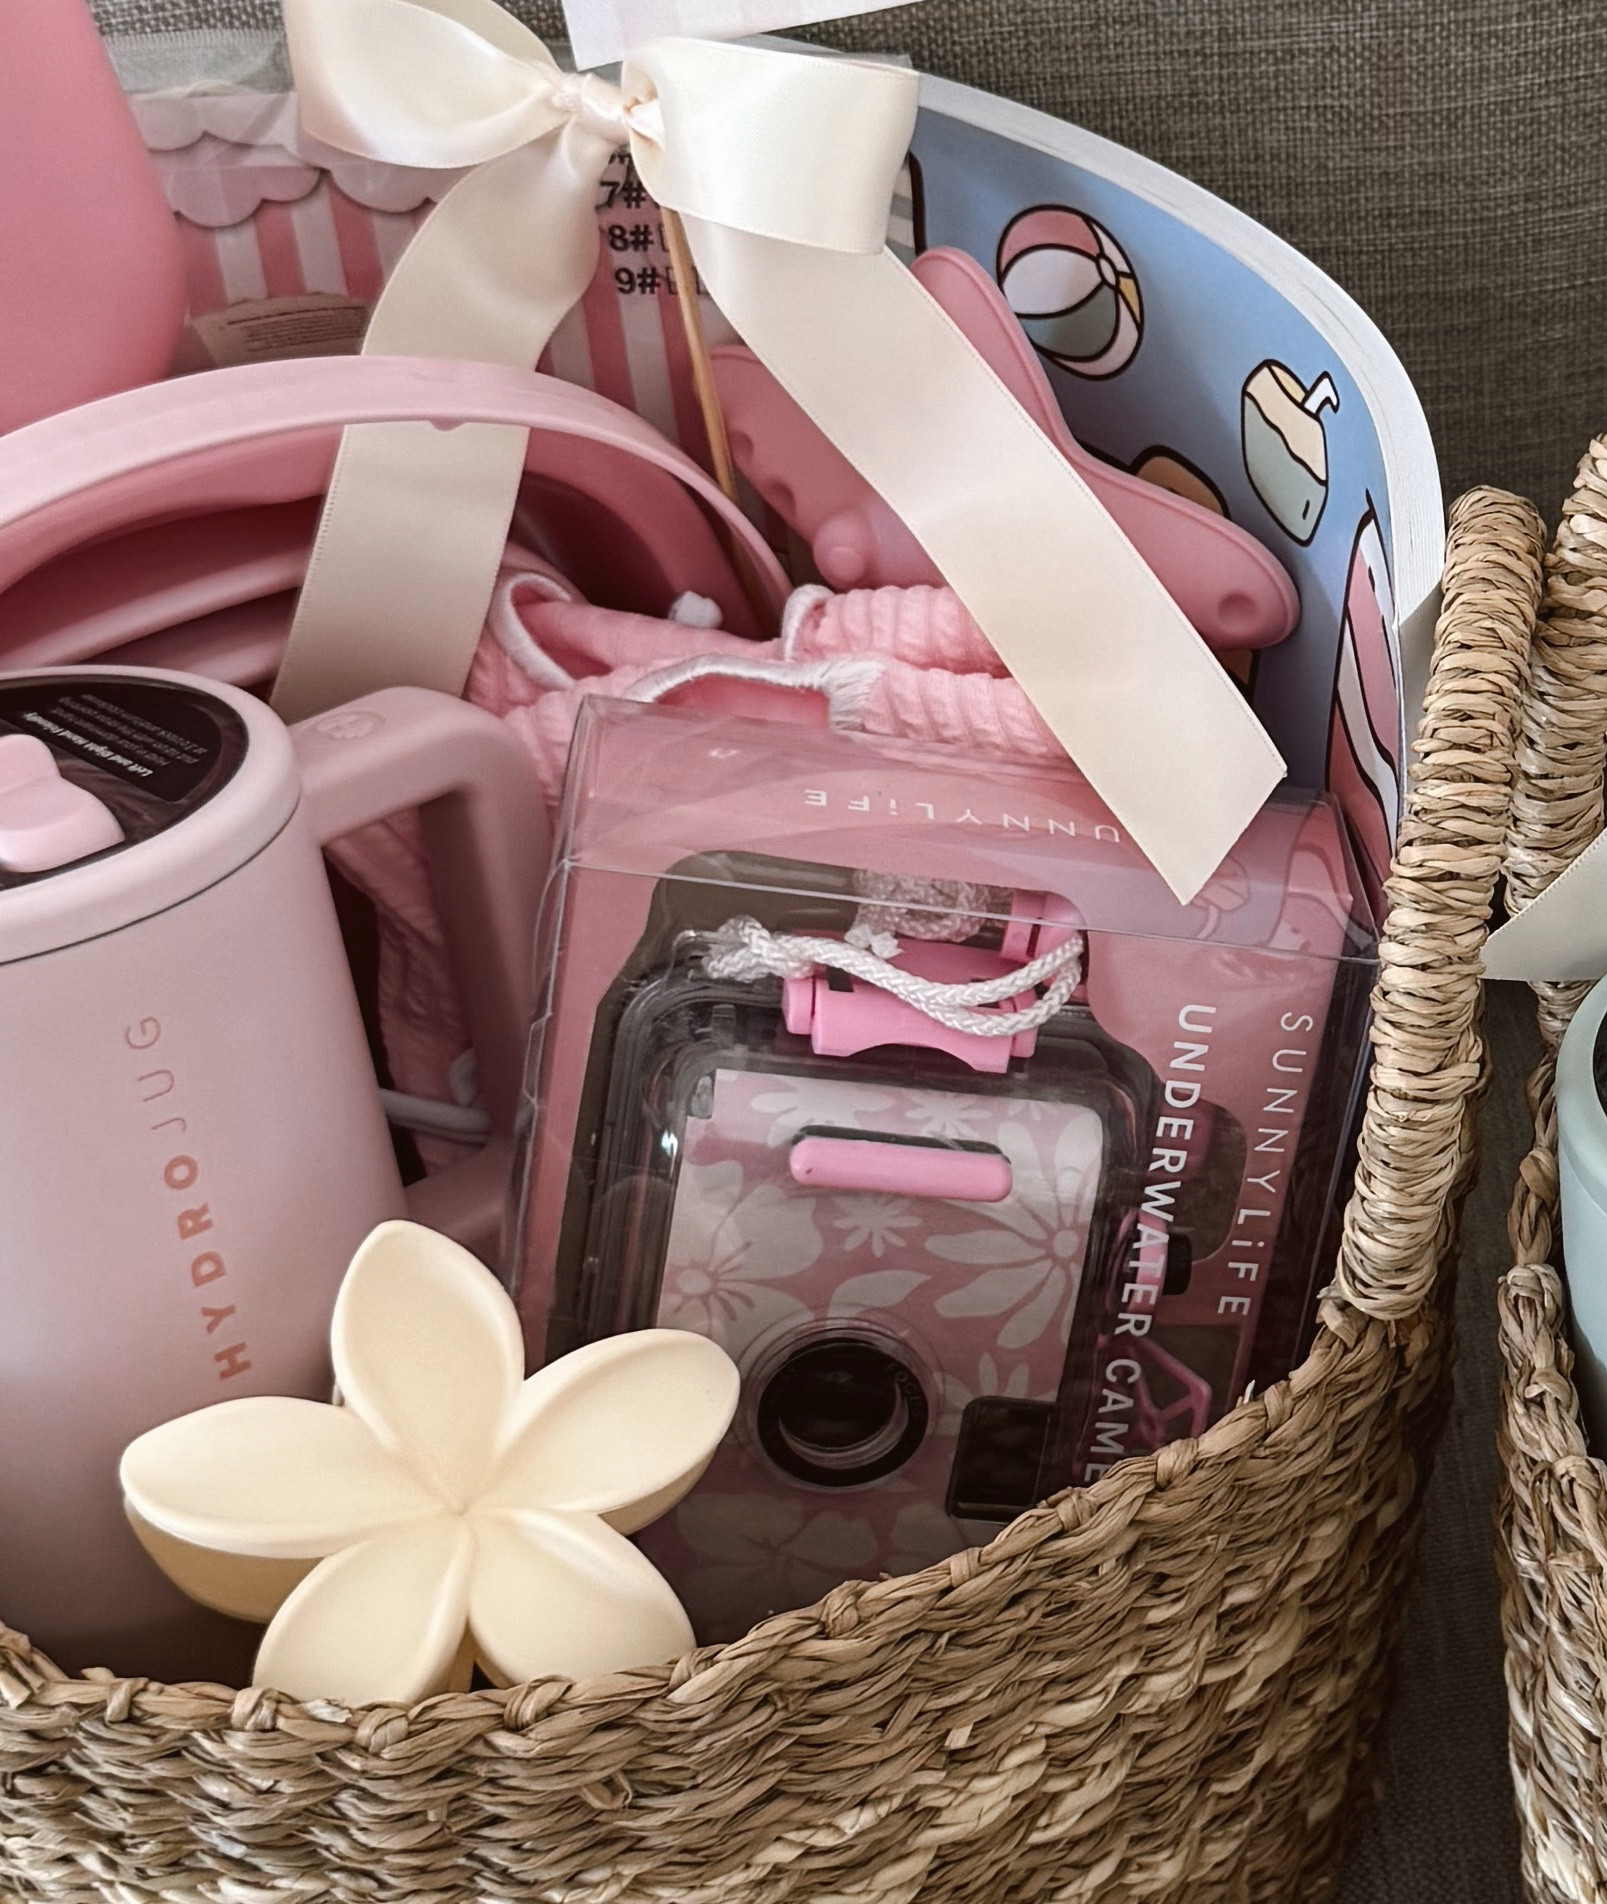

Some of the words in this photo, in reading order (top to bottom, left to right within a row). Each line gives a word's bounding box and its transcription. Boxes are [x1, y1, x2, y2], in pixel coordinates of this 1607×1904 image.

[125, 1015, 251, 1381] HYDROJUG
[1115, 1004, 1217, 1337] UNDERWATER
[1084, 1358, 1141, 1482] CAME
